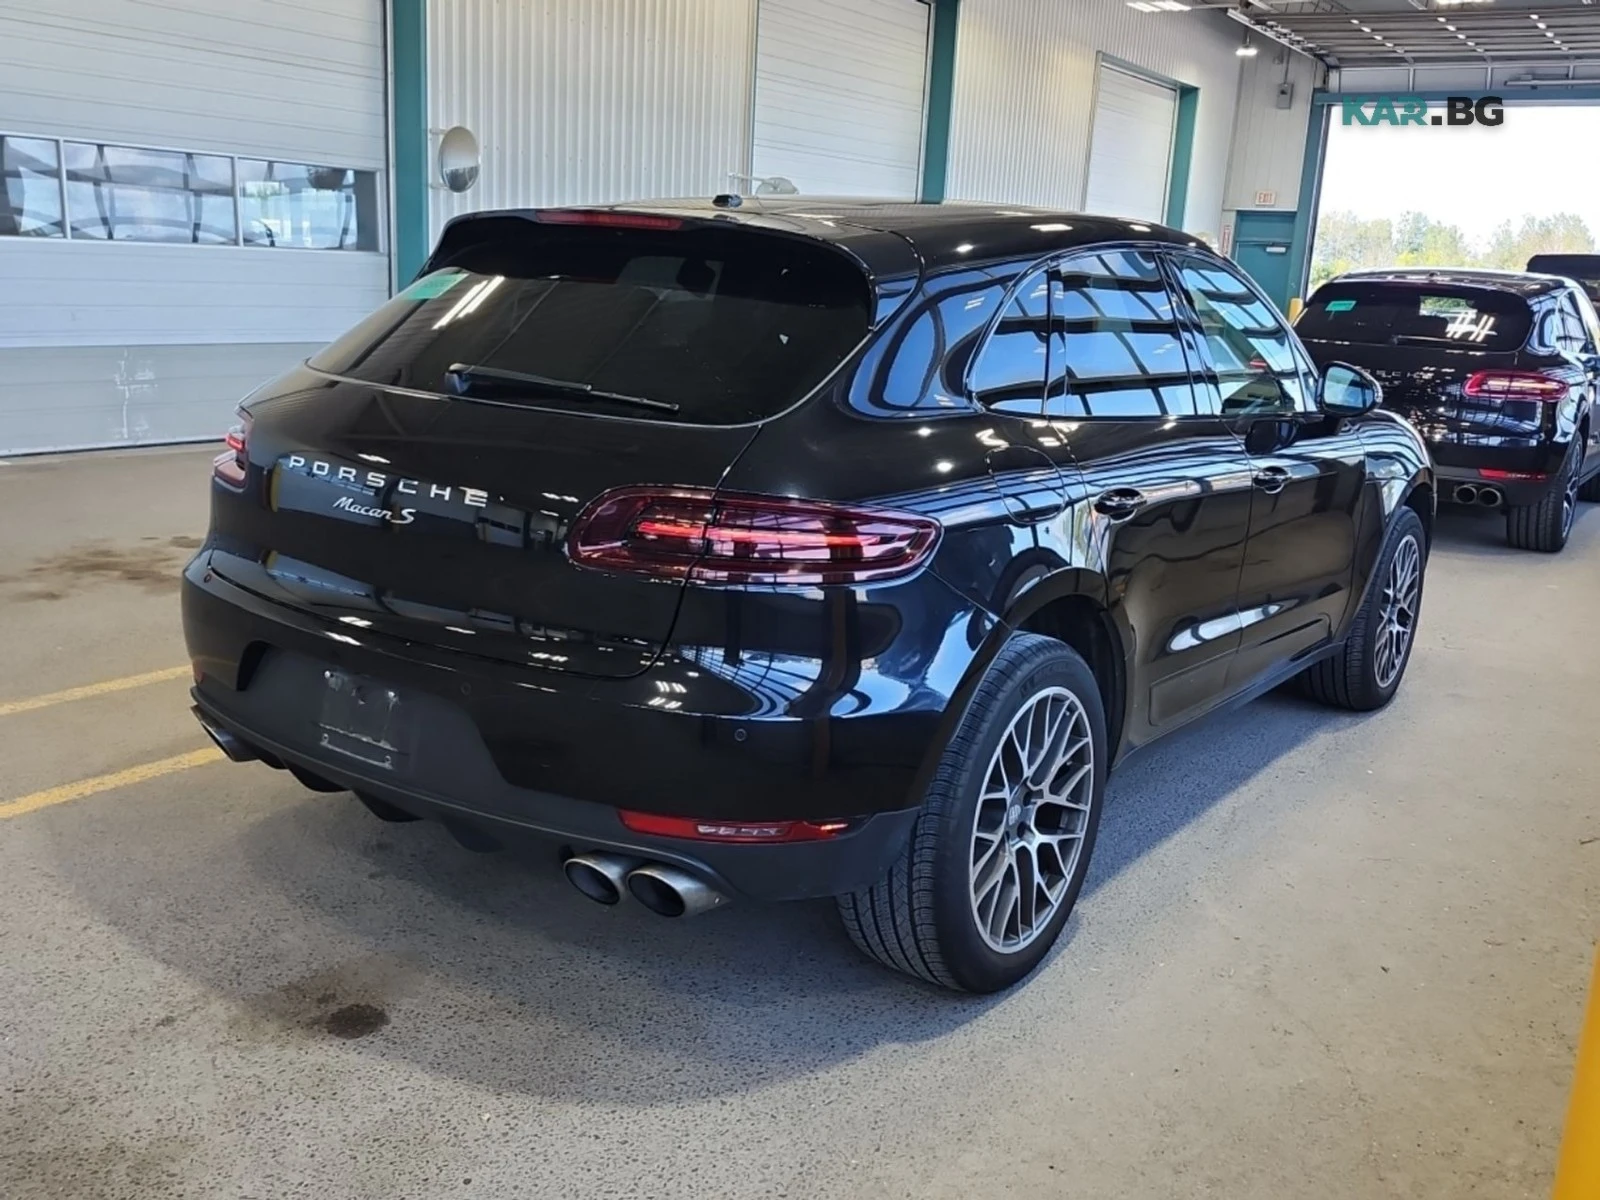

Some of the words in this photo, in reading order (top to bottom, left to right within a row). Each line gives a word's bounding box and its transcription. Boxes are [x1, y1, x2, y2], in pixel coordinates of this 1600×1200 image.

[1258, 192, 1273, 204] EXIT
[289, 455, 488, 508] PORSCHE
[333, 496, 393, 520] Macan
[390, 508, 417, 524] S
